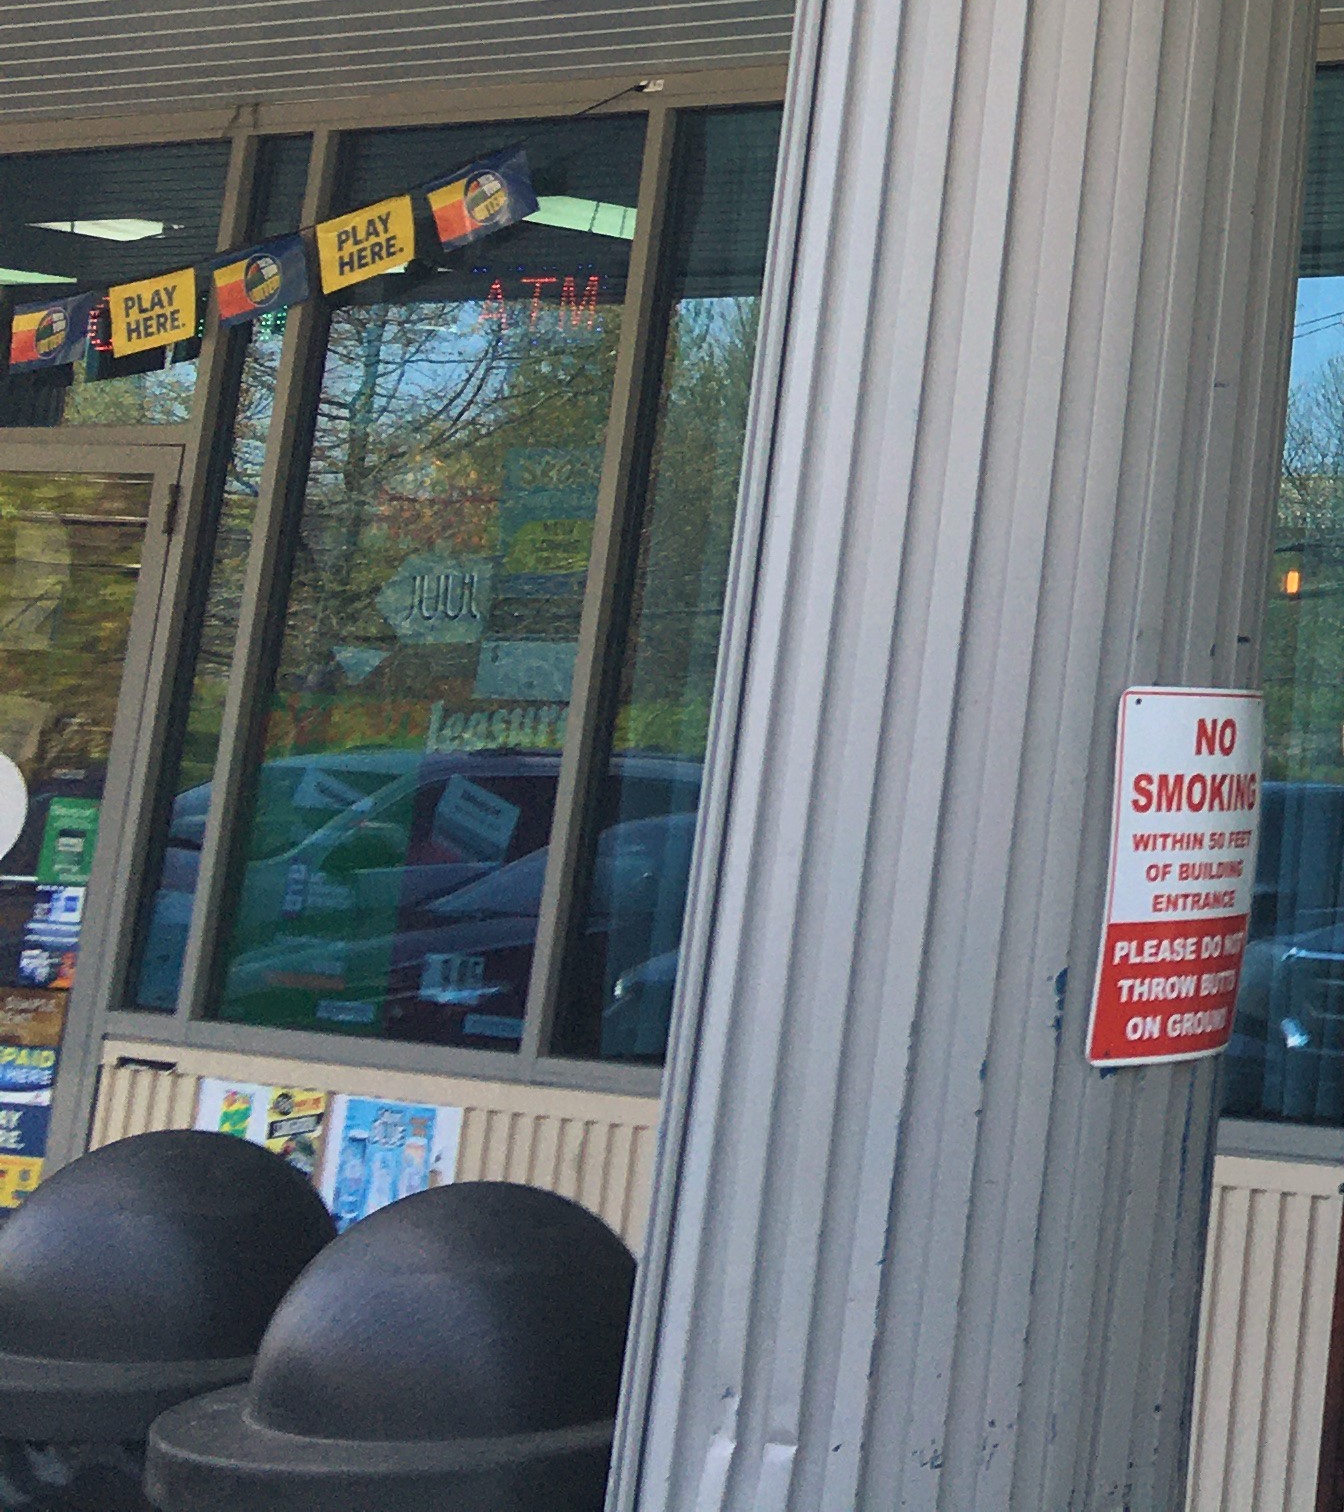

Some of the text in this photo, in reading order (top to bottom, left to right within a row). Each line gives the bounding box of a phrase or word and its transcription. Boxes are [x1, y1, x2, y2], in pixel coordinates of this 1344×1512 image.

[337, 210, 391, 252] PLAY
[339, 235, 404, 276] HERE.
[123, 285, 178, 318] PLAY
[477, 275, 600, 332] ATM
[126, 308, 186, 342] HERE.
[1195, 718, 1237, 756] NO
[1131, 773, 1257, 813] SMOKING
[1132, 829, 1252, 851] WITHIN 50 FEET
[1145, 859, 1244, 882] OF BUILDING
[1152, 889, 1236, 913] ENTRANCE
[1112, 936, 1199, 966] PLEASE
[1201, 934, 1222, 960] DO
[1117, 974, 1198, 1003] THROW
[1126, 1006, 1228, 1041] ON GROUND
